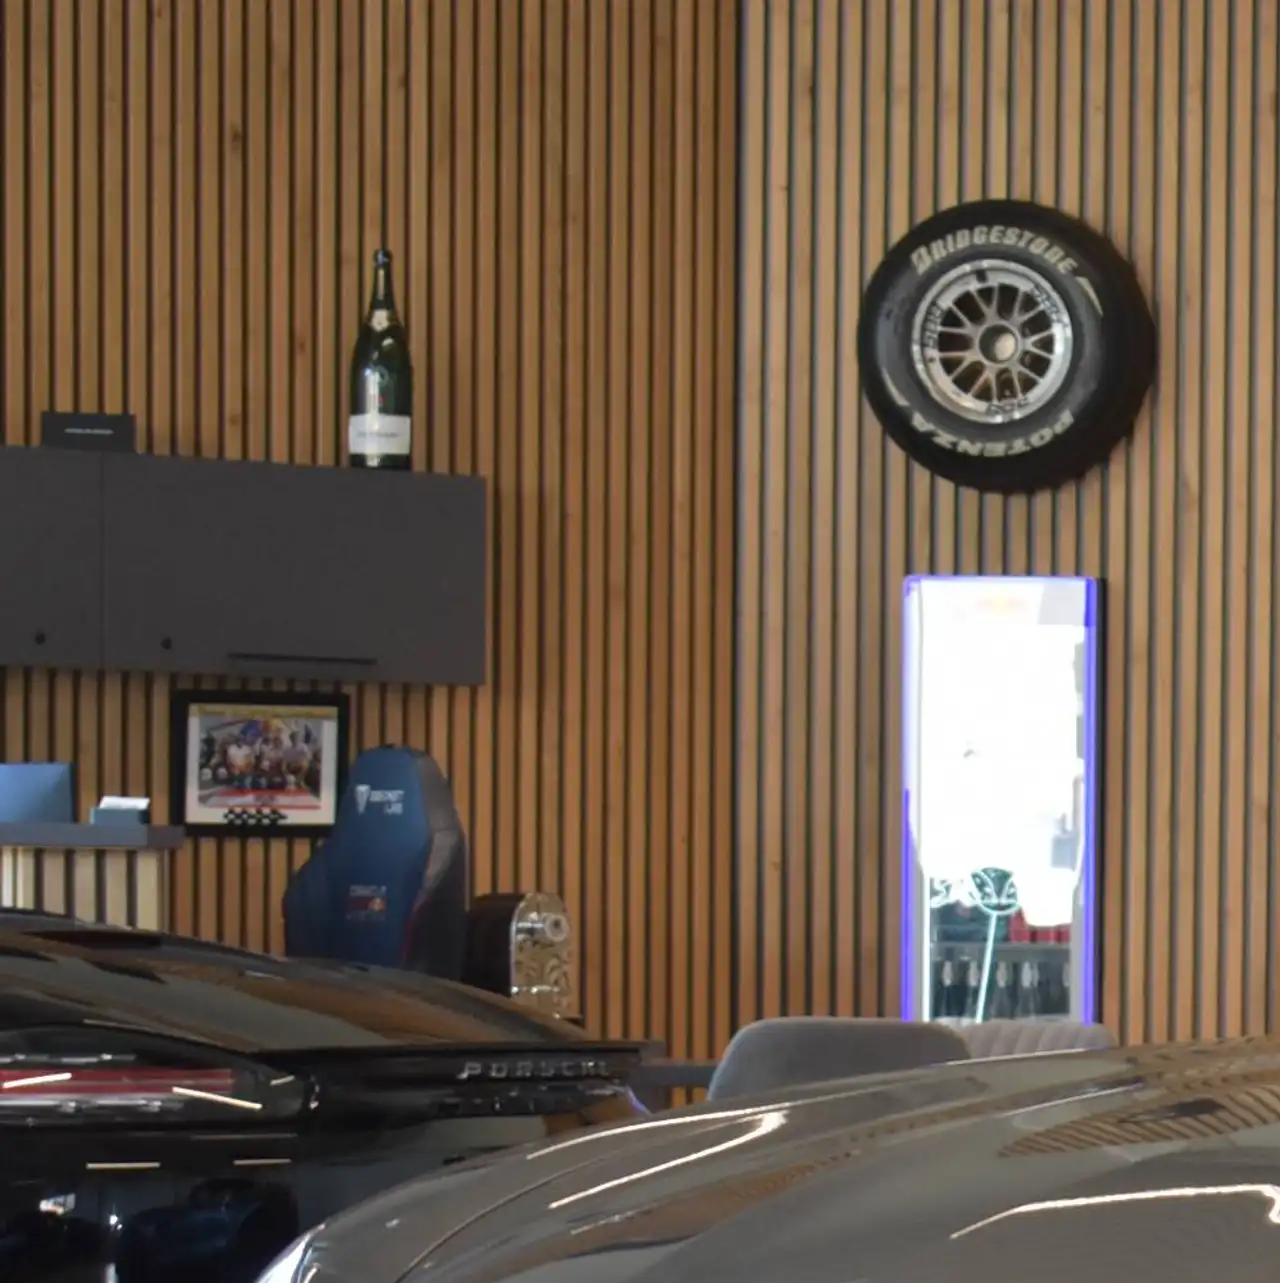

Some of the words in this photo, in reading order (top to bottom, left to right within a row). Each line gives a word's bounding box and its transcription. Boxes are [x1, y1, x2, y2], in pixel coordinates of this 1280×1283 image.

[910, 225, 1077, 276] BRIDGESTONE
[912, 409, 1075, 457] POTENZA
[457, 1060, 611, 1080] PORSCHE
